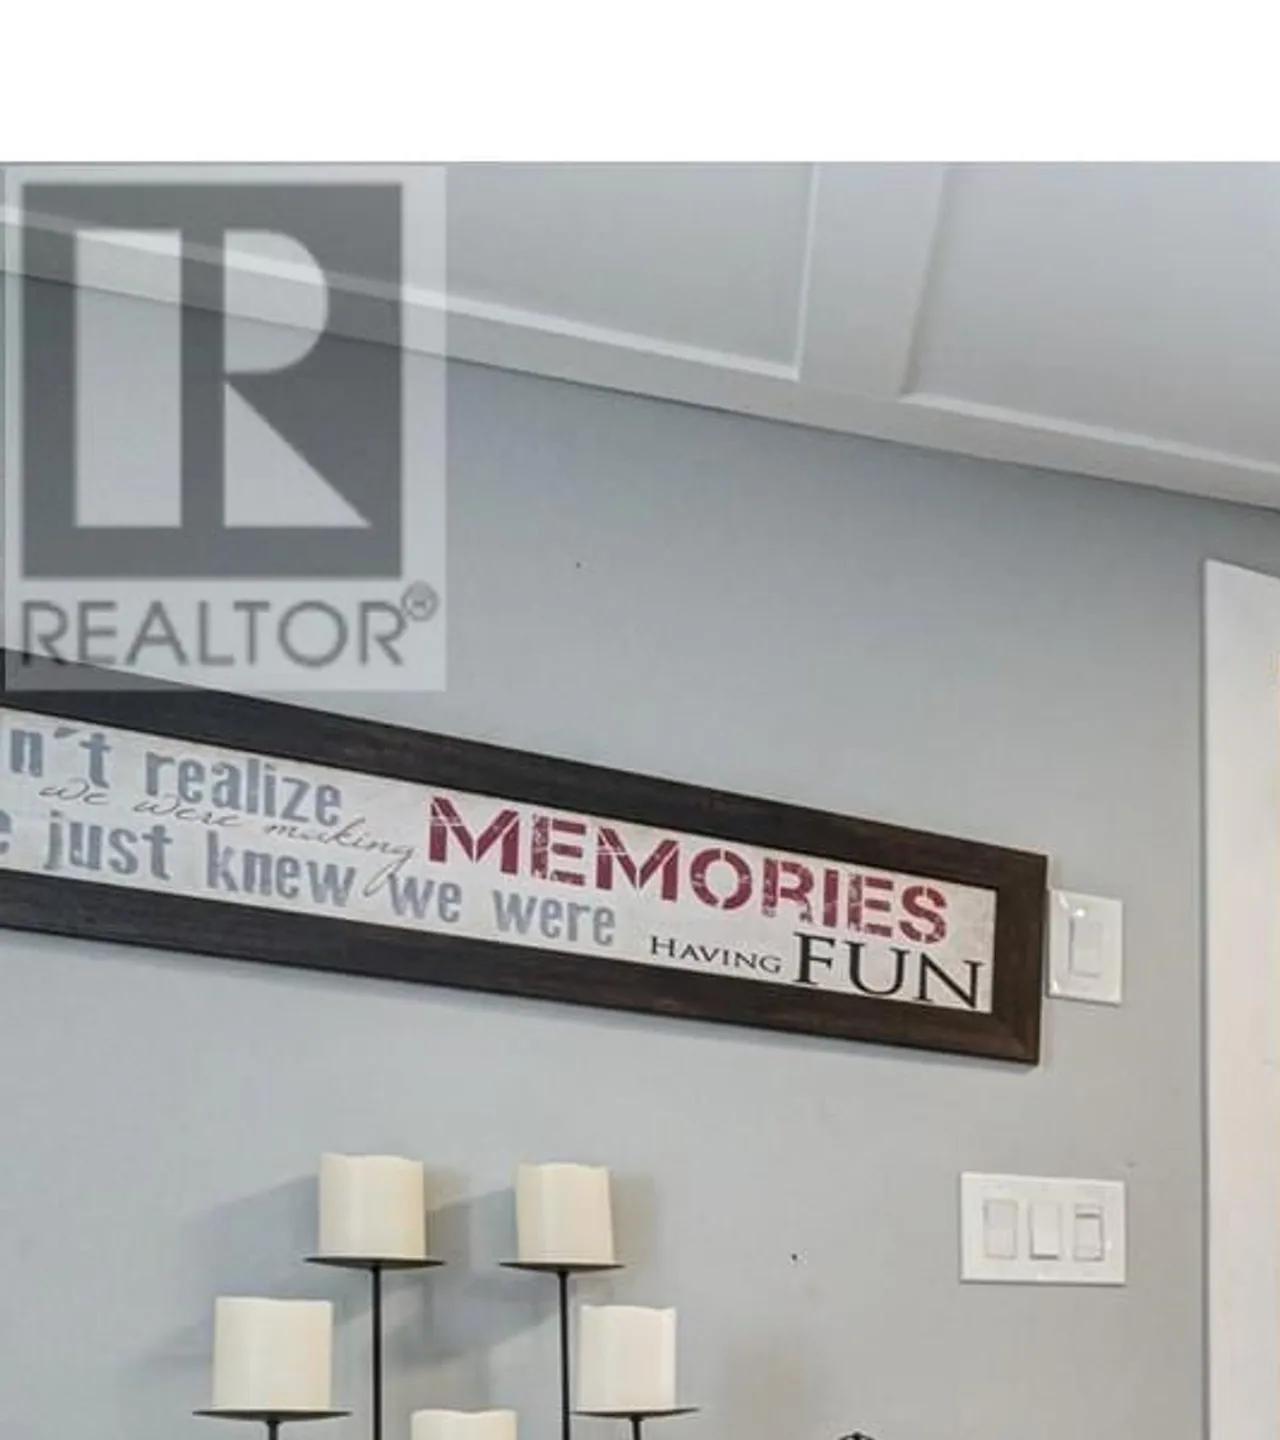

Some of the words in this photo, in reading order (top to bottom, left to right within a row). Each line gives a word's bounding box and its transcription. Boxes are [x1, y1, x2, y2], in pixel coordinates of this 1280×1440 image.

[38, 776, 110, 806] we
[132, 793, 243, 827] were
[264, 816, 416, 898] making
[426, 795, 949, 945] MEMORIES
[144, 750, 342, 828] realize
[42, 809, 173, 881] just
[206, 829, 356, 908] knew
[386, 871, 463, 924] we
[493, 888, 617, 947] were
[650, 934, 782, 975] HAVING
[793, 929, 986, 1009] FUN
